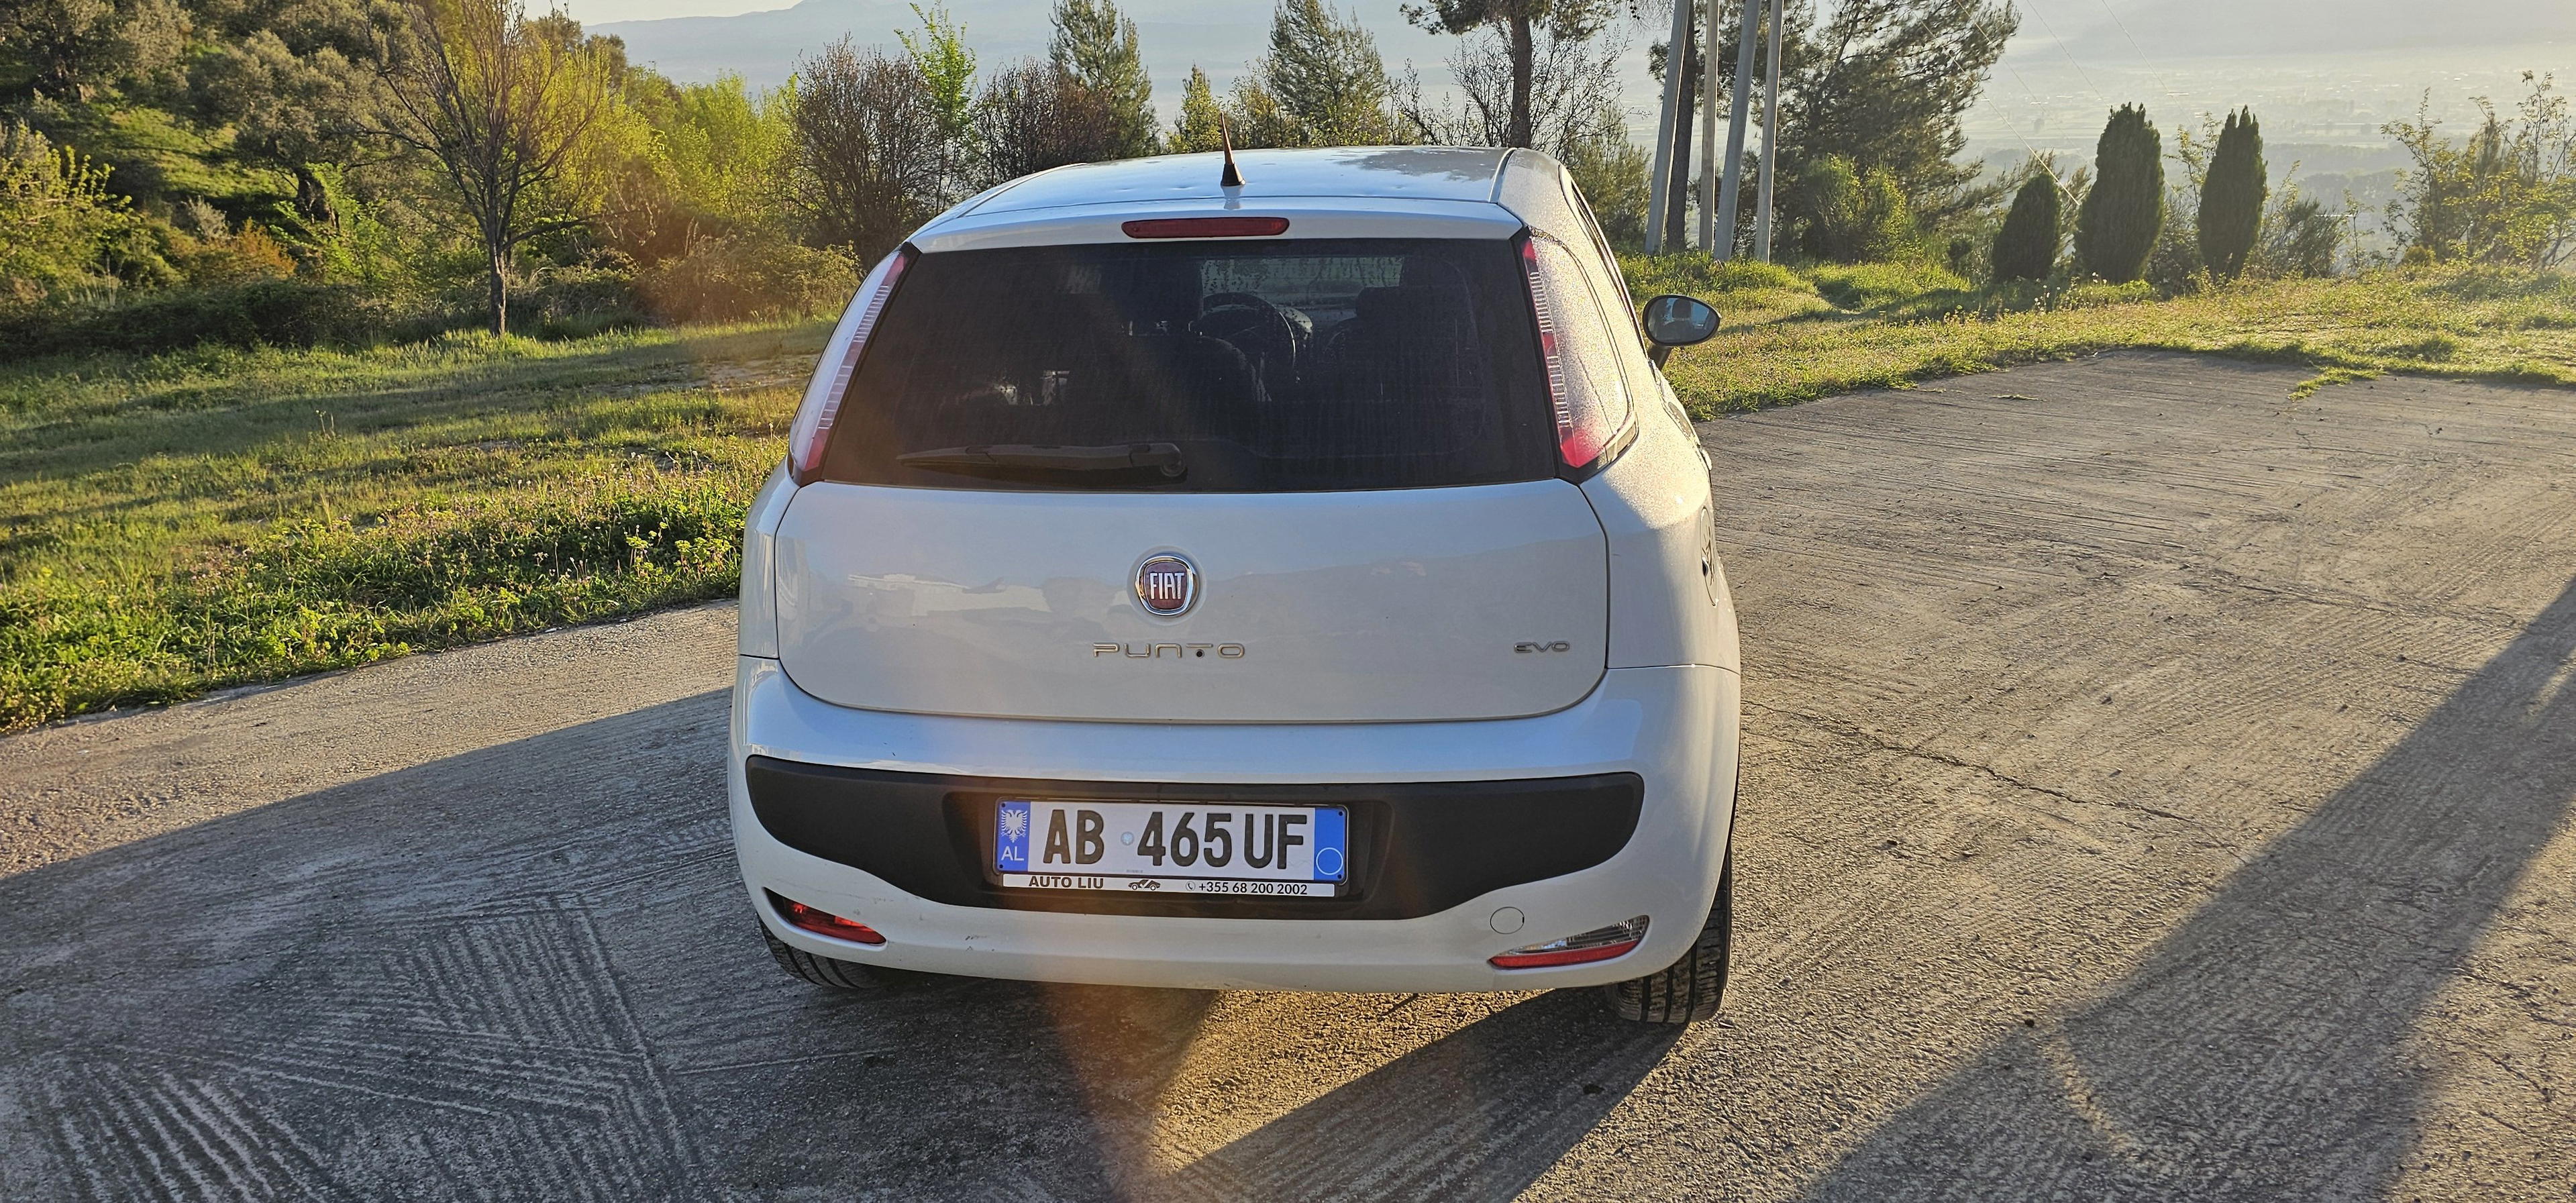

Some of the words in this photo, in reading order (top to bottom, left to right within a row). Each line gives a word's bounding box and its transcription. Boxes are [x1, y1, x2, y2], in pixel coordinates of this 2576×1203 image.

[1149, 572, 1185, 600] FIAT
[1092, 641, 1245, 659] PUNTO
[1514, 641, 1570, 653] EVO
[1043, 808, 1104, 865] AB
[1000, 845, 1025, 861] AL
[1029, 876, 1072, 888] AUTO
[1078, 877, 1104, 889] LIU
[1198, 881, 1229, 893] +355
[1232, 882, 1248, 894] 68
[1250, 882, 1274, 894] 200
[1276, 883, 1308, 896] 2002
